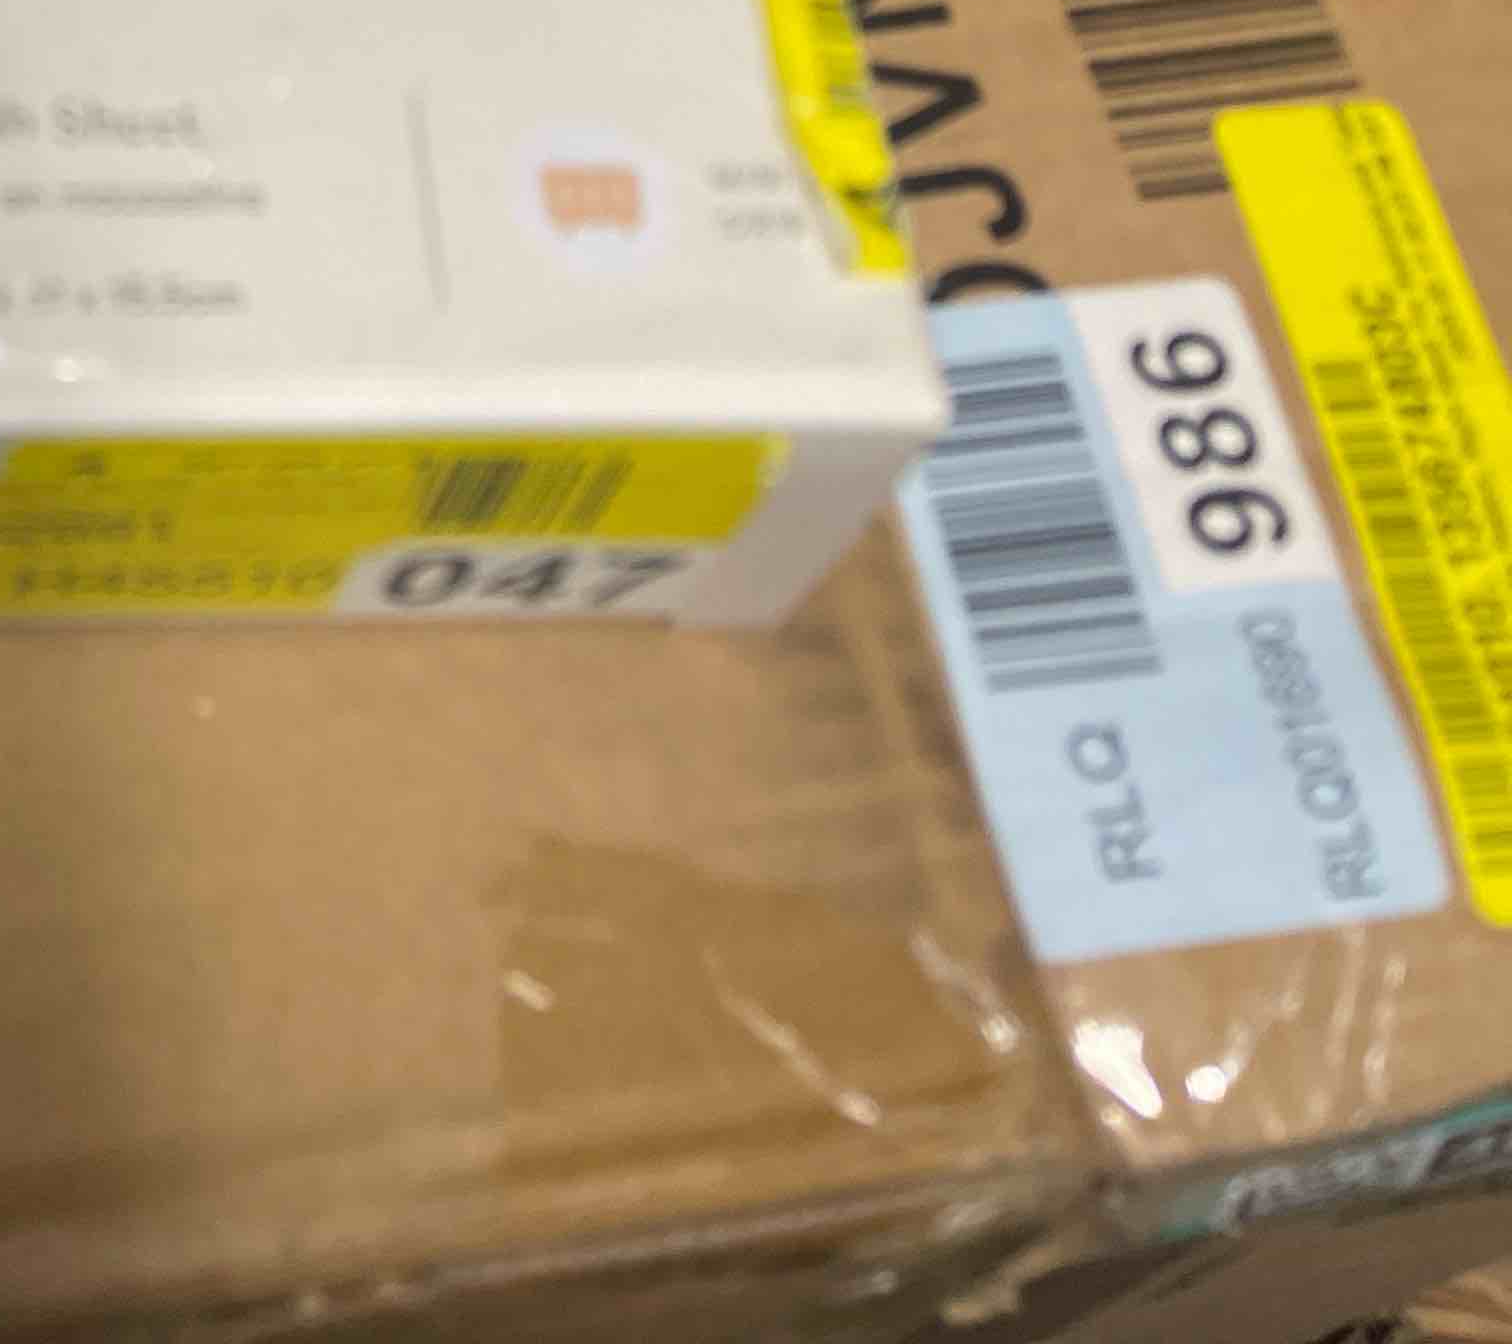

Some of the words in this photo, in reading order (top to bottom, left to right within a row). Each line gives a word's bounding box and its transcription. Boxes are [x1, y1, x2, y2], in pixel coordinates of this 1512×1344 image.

[1129, 328, 1290, 556] 986
[378, 550, 688, 608] 047
[1062, 715, 1161, 887] RLQ
